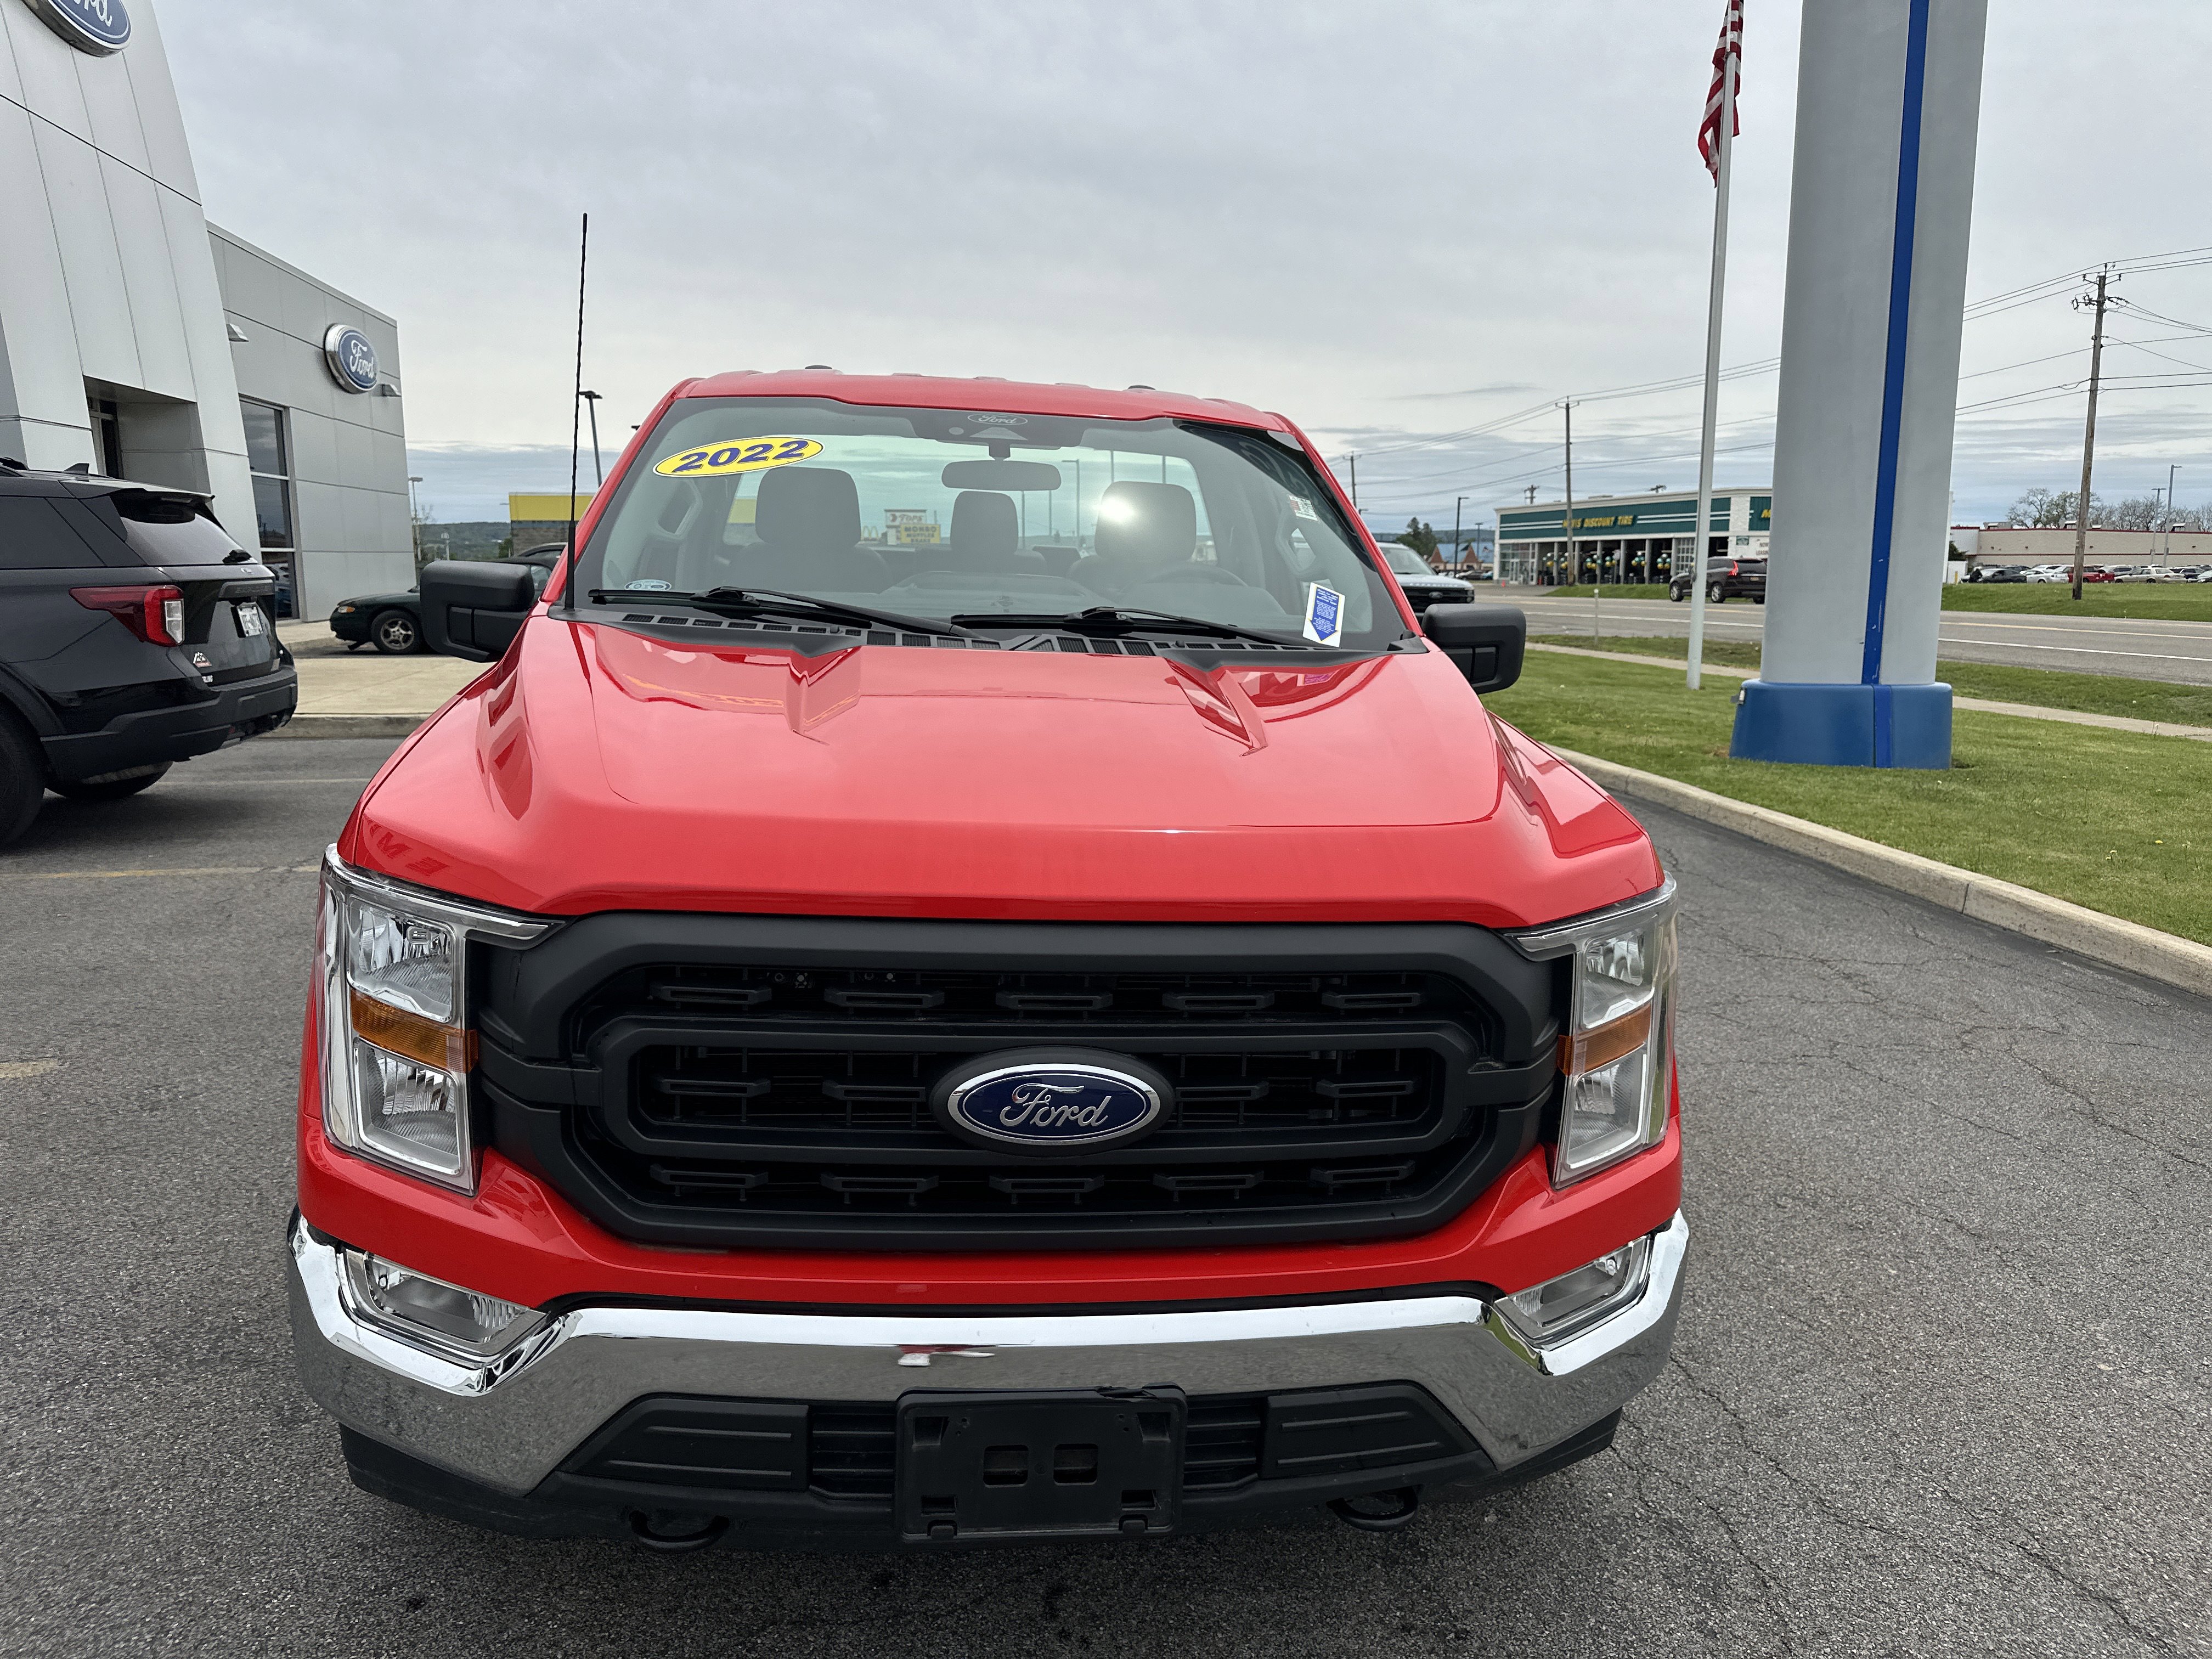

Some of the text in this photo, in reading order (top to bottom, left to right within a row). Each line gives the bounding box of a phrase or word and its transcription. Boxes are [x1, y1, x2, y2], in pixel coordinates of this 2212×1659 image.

[349, 340, 374, 379] Ford
[978, 415, 1018, 424] Ford
[672, 439, 810, 473] 2022
[999, 1083, 1112, 1127] Ford
